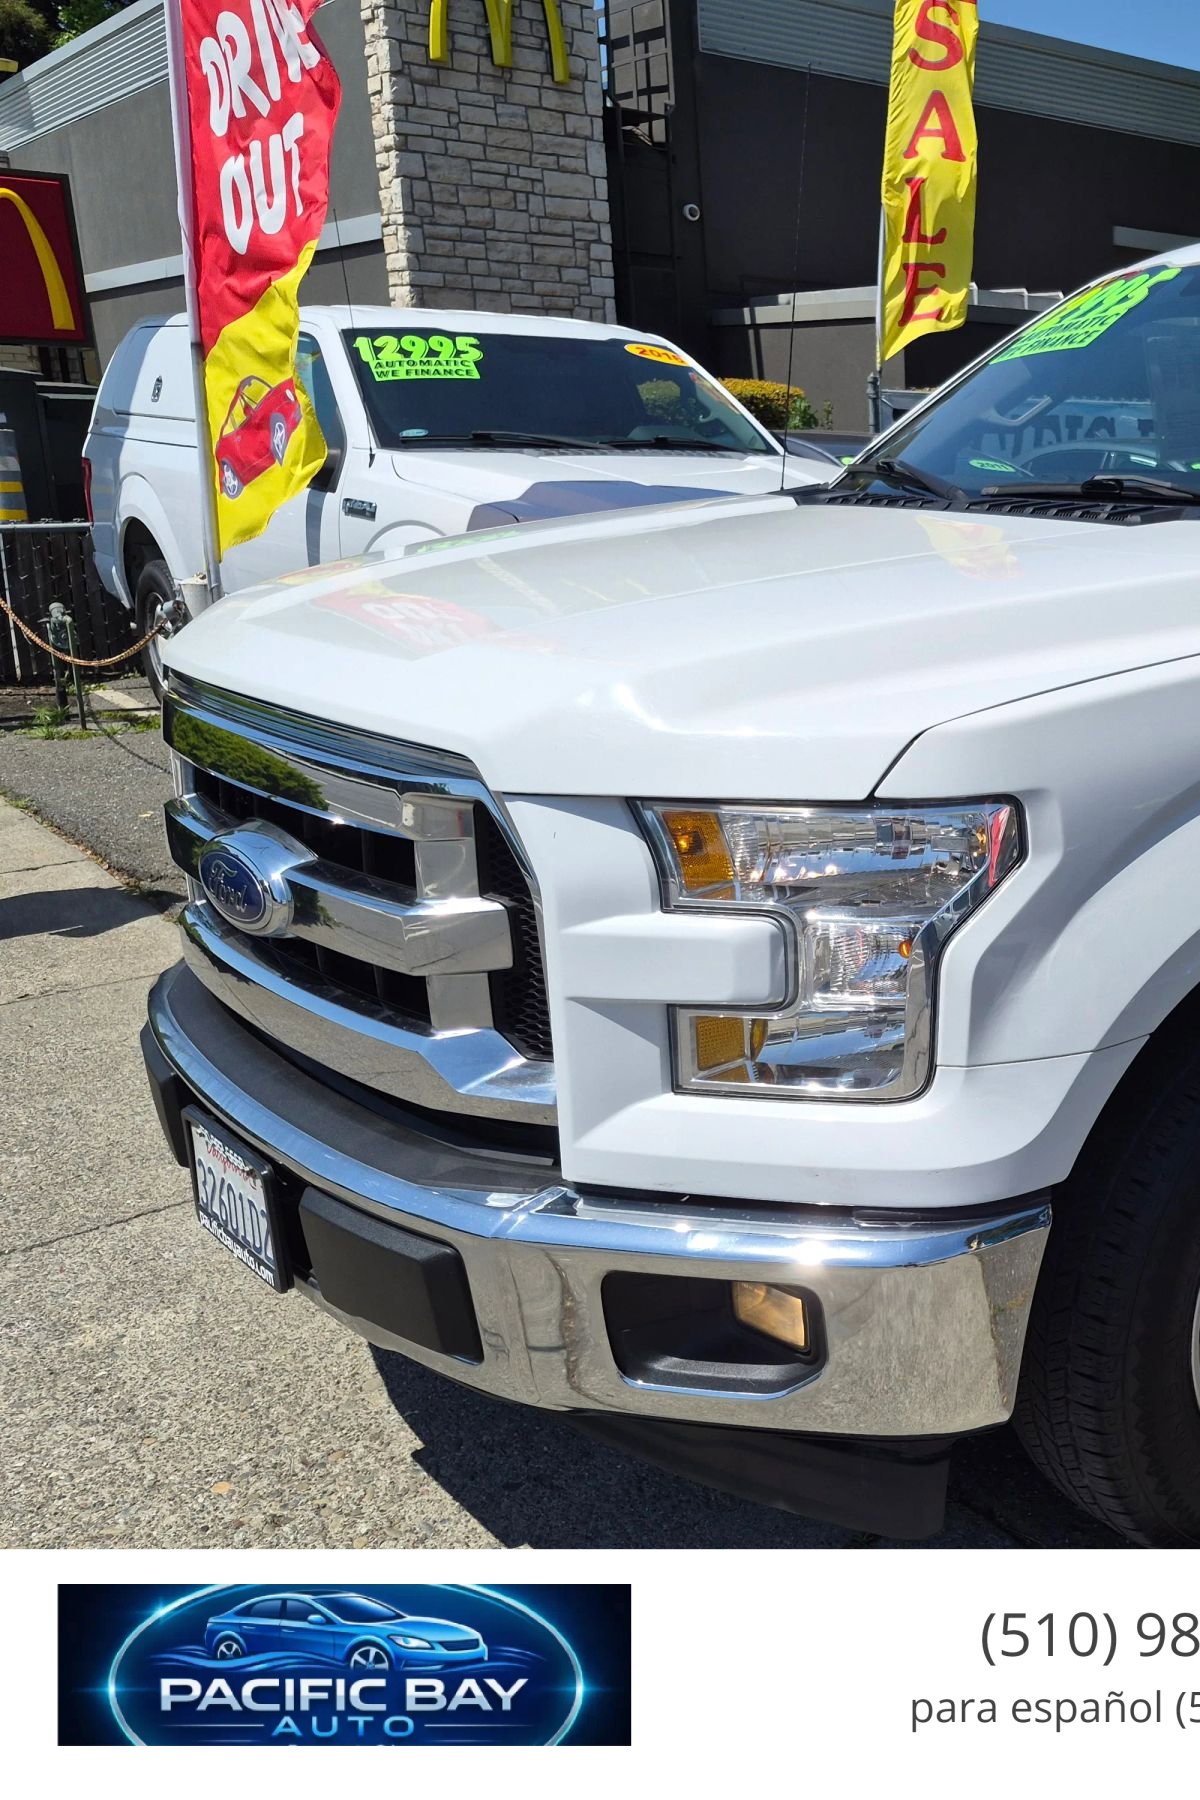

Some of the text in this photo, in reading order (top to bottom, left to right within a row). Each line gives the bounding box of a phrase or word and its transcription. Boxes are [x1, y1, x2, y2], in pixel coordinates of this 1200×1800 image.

[220, 112, 304, 255] OUT
[898, 0, 966, 328] SALE
[353, 335, 483, 362] 12995
[374, 359, 471, 369] AUTOMATIC
[375, 368, 474, 378] WE FINANCE
[208, 859, 248, 914] Ford
